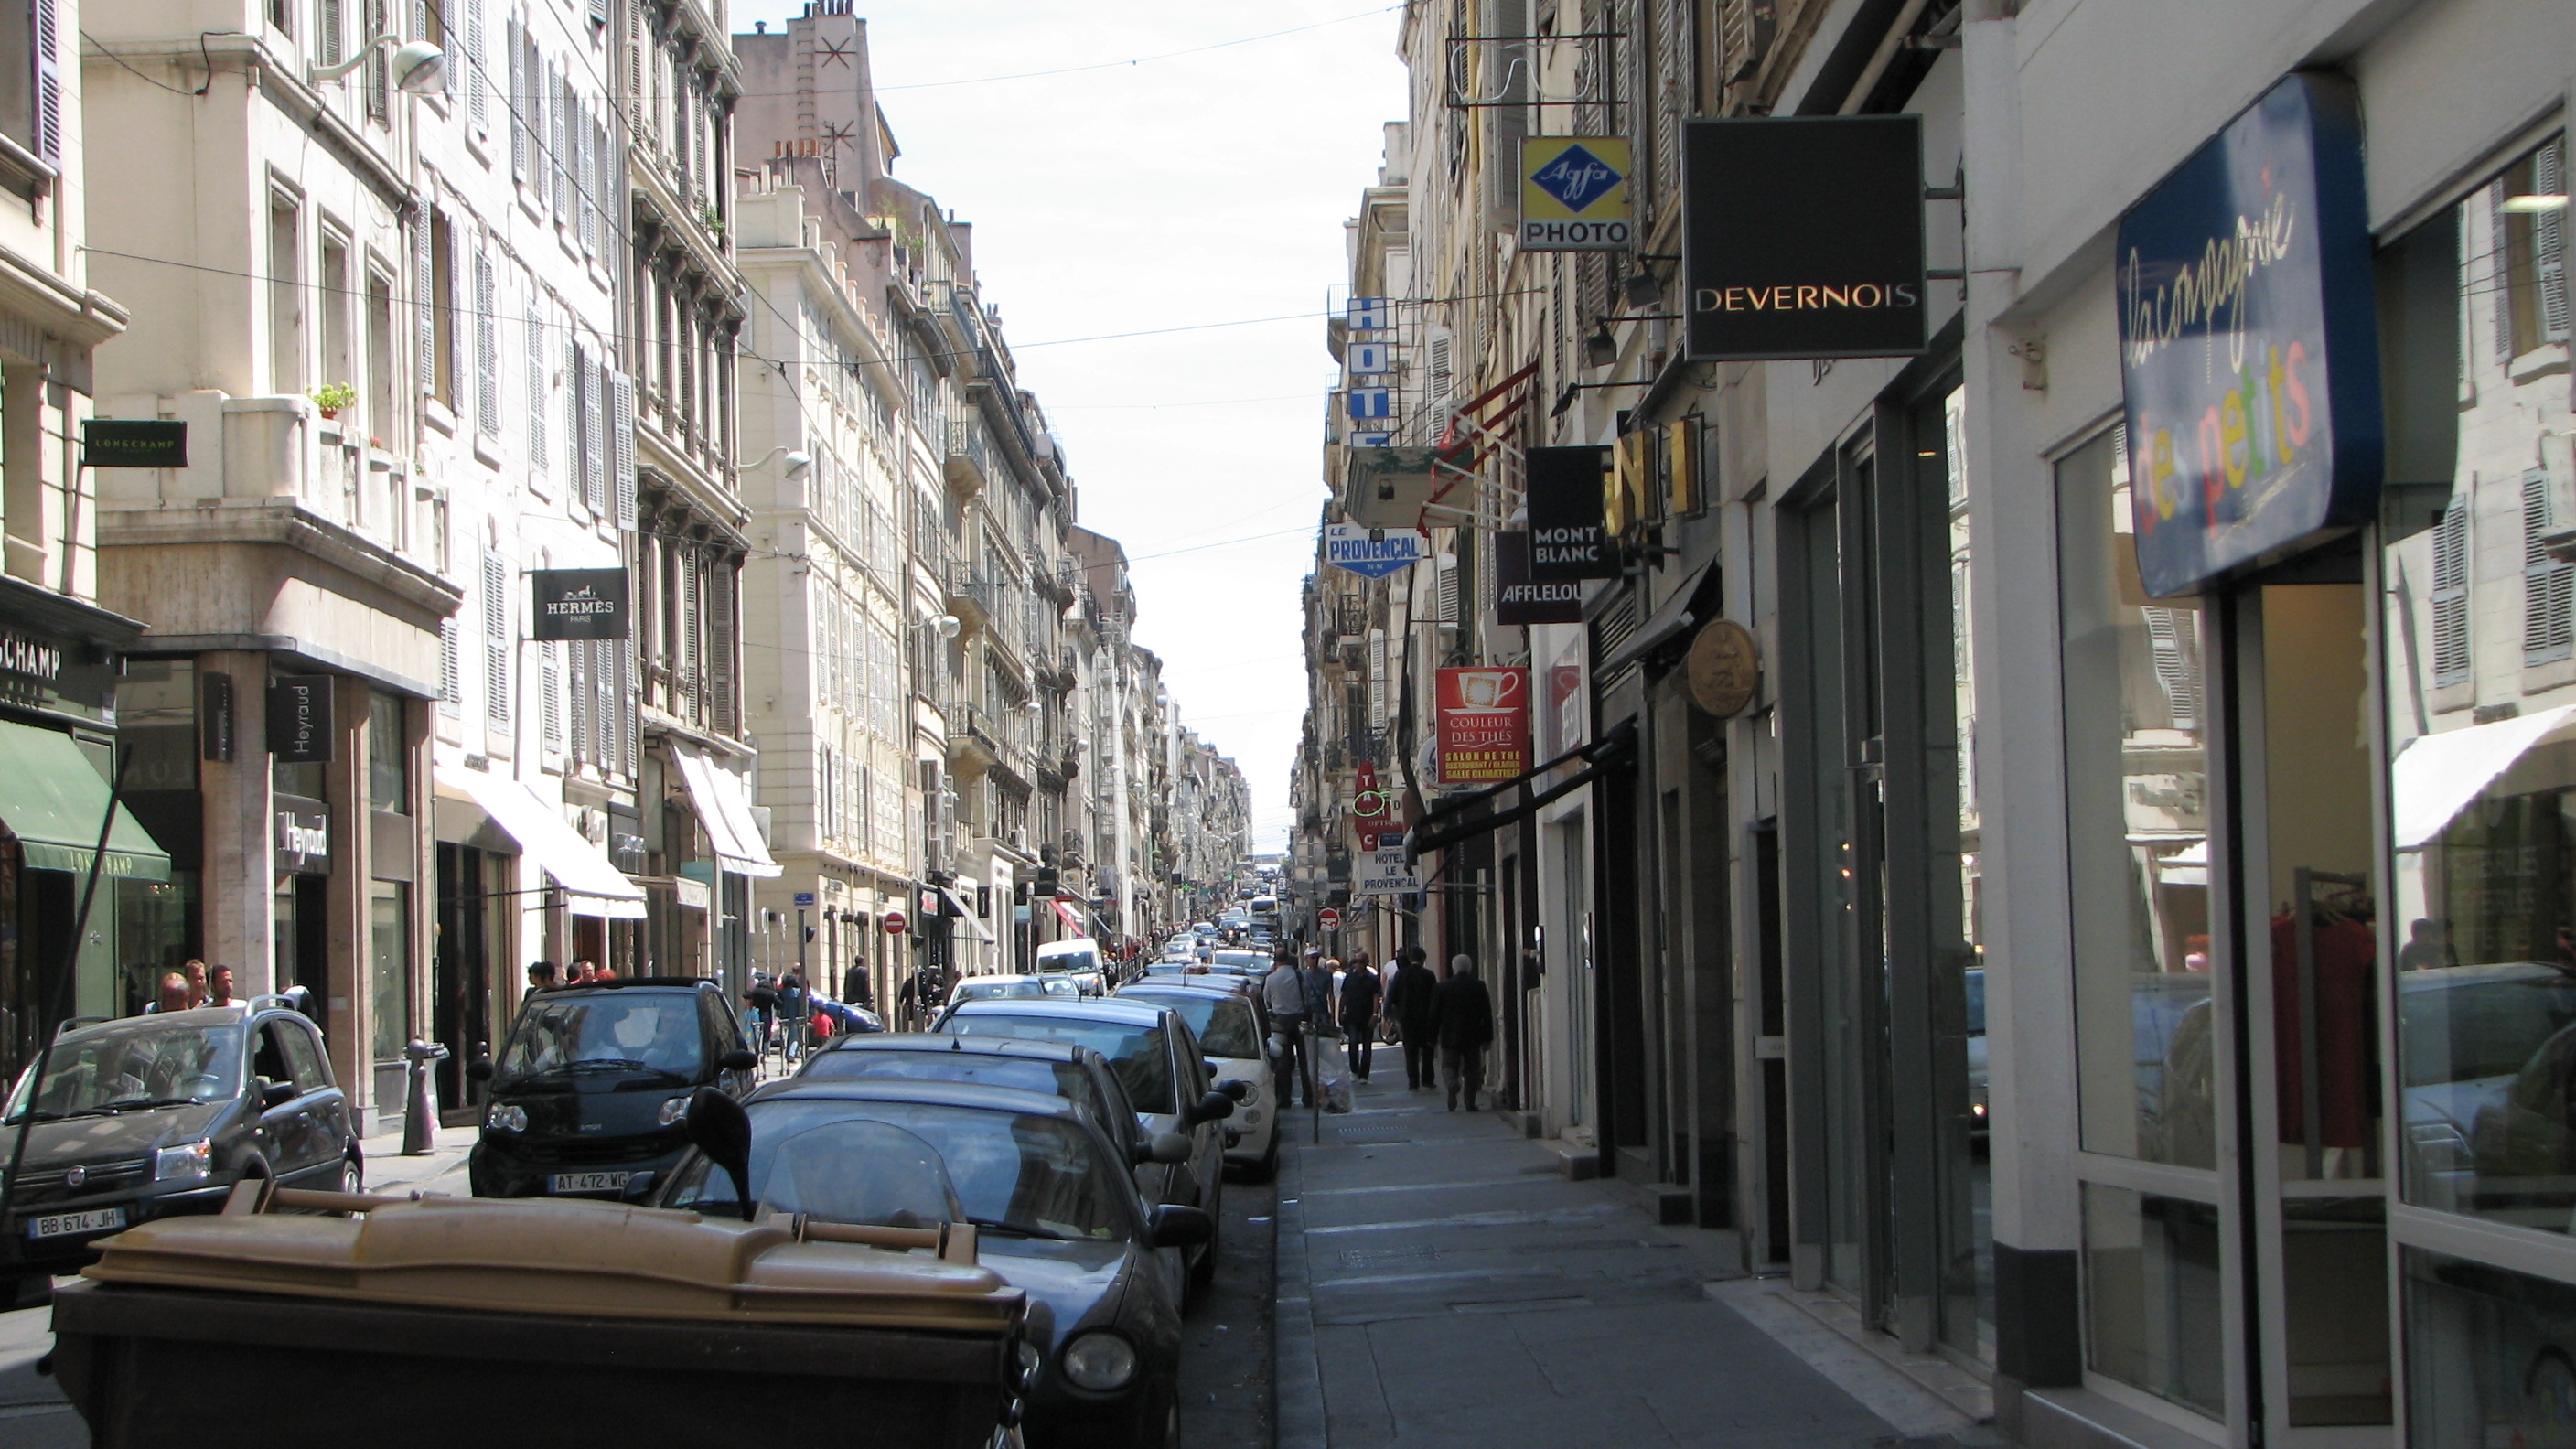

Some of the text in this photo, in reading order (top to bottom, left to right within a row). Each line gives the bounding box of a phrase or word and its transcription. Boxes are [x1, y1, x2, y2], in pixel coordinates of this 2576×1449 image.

[1540, 161, 1608, 199] Agfa
[1526, 222, 1627, 243] PHOTO
[1695, 283, 1917, 313] DEVERNOIS
[95, 439, 175, 449] LONGCHAMP
[2199, 340, 2311, 542] petits
[1330, 527, 1347, 536] LE
[1535, 527, 1597, 544] MONT
[1536, 545, 1599, 563] BLANC
[570, 615, 592, 623] PARIS
[0, 631, 61, 680] CHAMP
[292, 685, 314, 753] Heyraud
[1449, 717, 1513, 728] COULEUR
[1452, 731, 1476, 743] DES
[1445, 752, 1480, 761] SALON
[1484, 751, 1497, 760] DE
[277, 810, 327, 865] Heyraud
[70, 850, 133, 875] LONHAMP
[1375, 853, 1405, 864] HOTEL
[1385, 865, 1397, 875] LE
